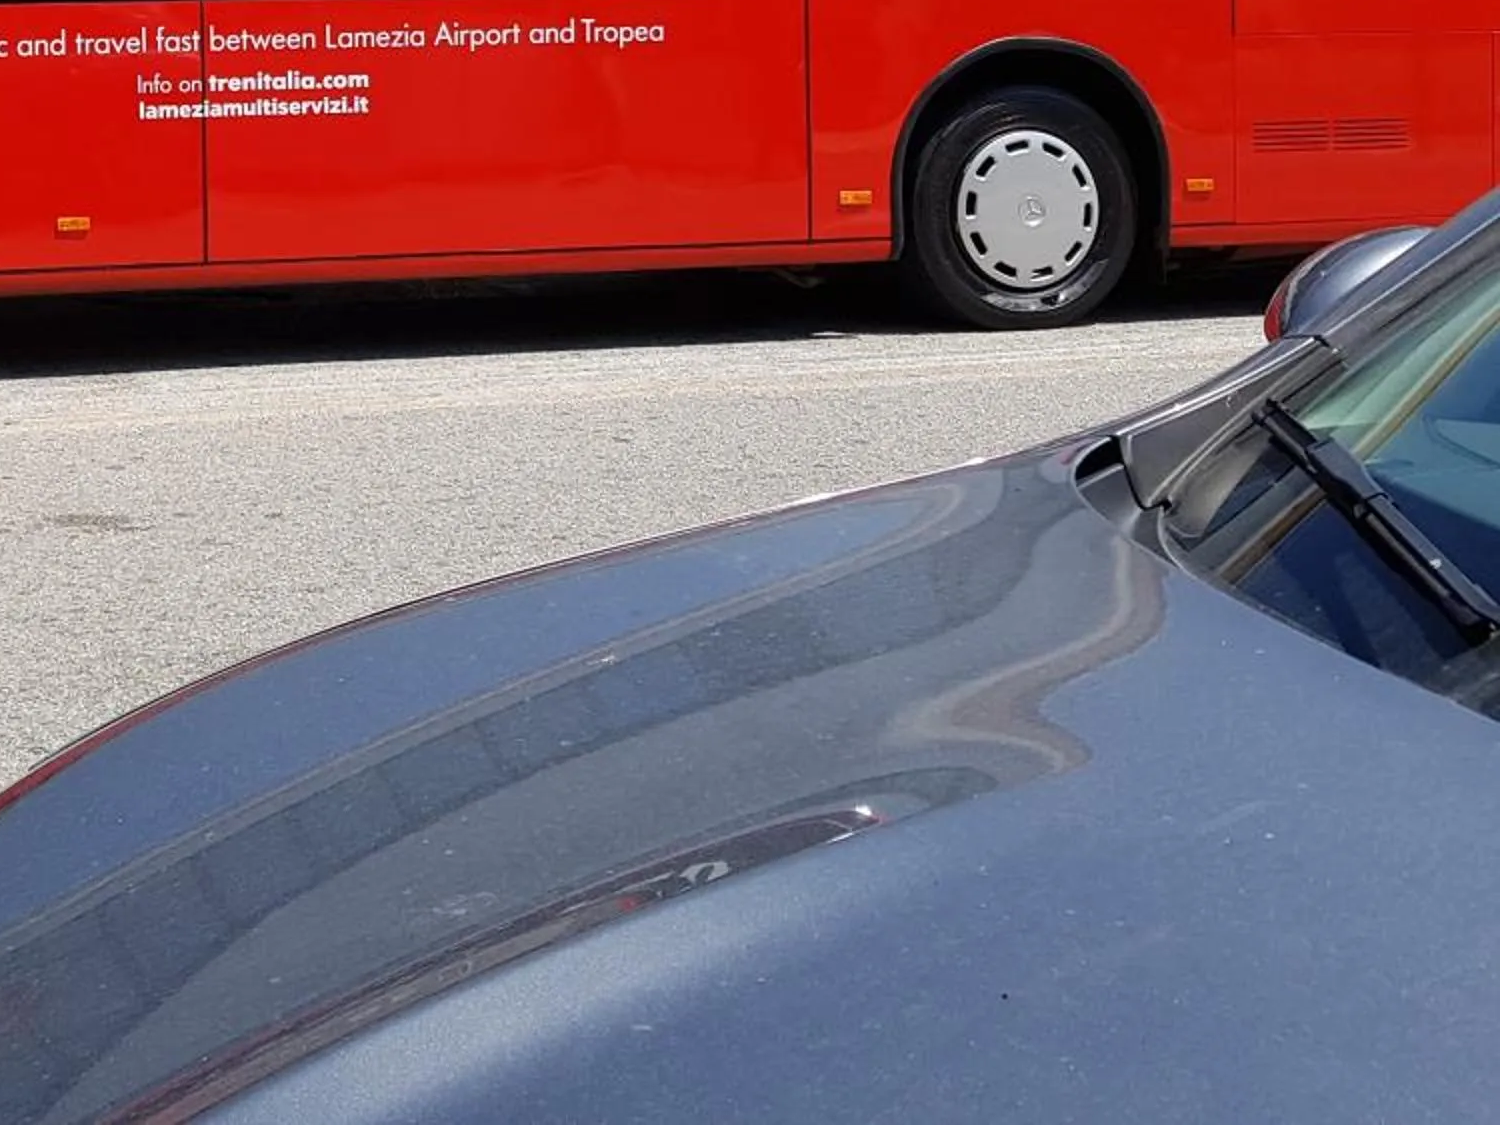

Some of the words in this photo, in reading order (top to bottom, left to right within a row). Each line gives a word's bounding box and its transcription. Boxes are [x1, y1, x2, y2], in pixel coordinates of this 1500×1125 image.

[16, 28, 67, 57] and
[75, 26, 147, 55] travel
[155, 25, 201, 54] fast
[209, 24, 317, 52] between
[325, 23, 426, 49] Lamezia
[433, 21, 521, 52] Airport
[528, 18, 575, 45] and
[581, 18, 665, 49] Tropea
[137, 73, 172, 94] Info
[179, 80, 202, 94] on
[208, 69, 370, 92] trenitalia.com
[139, 96, 370, 121] lameziamultiservizi.it
